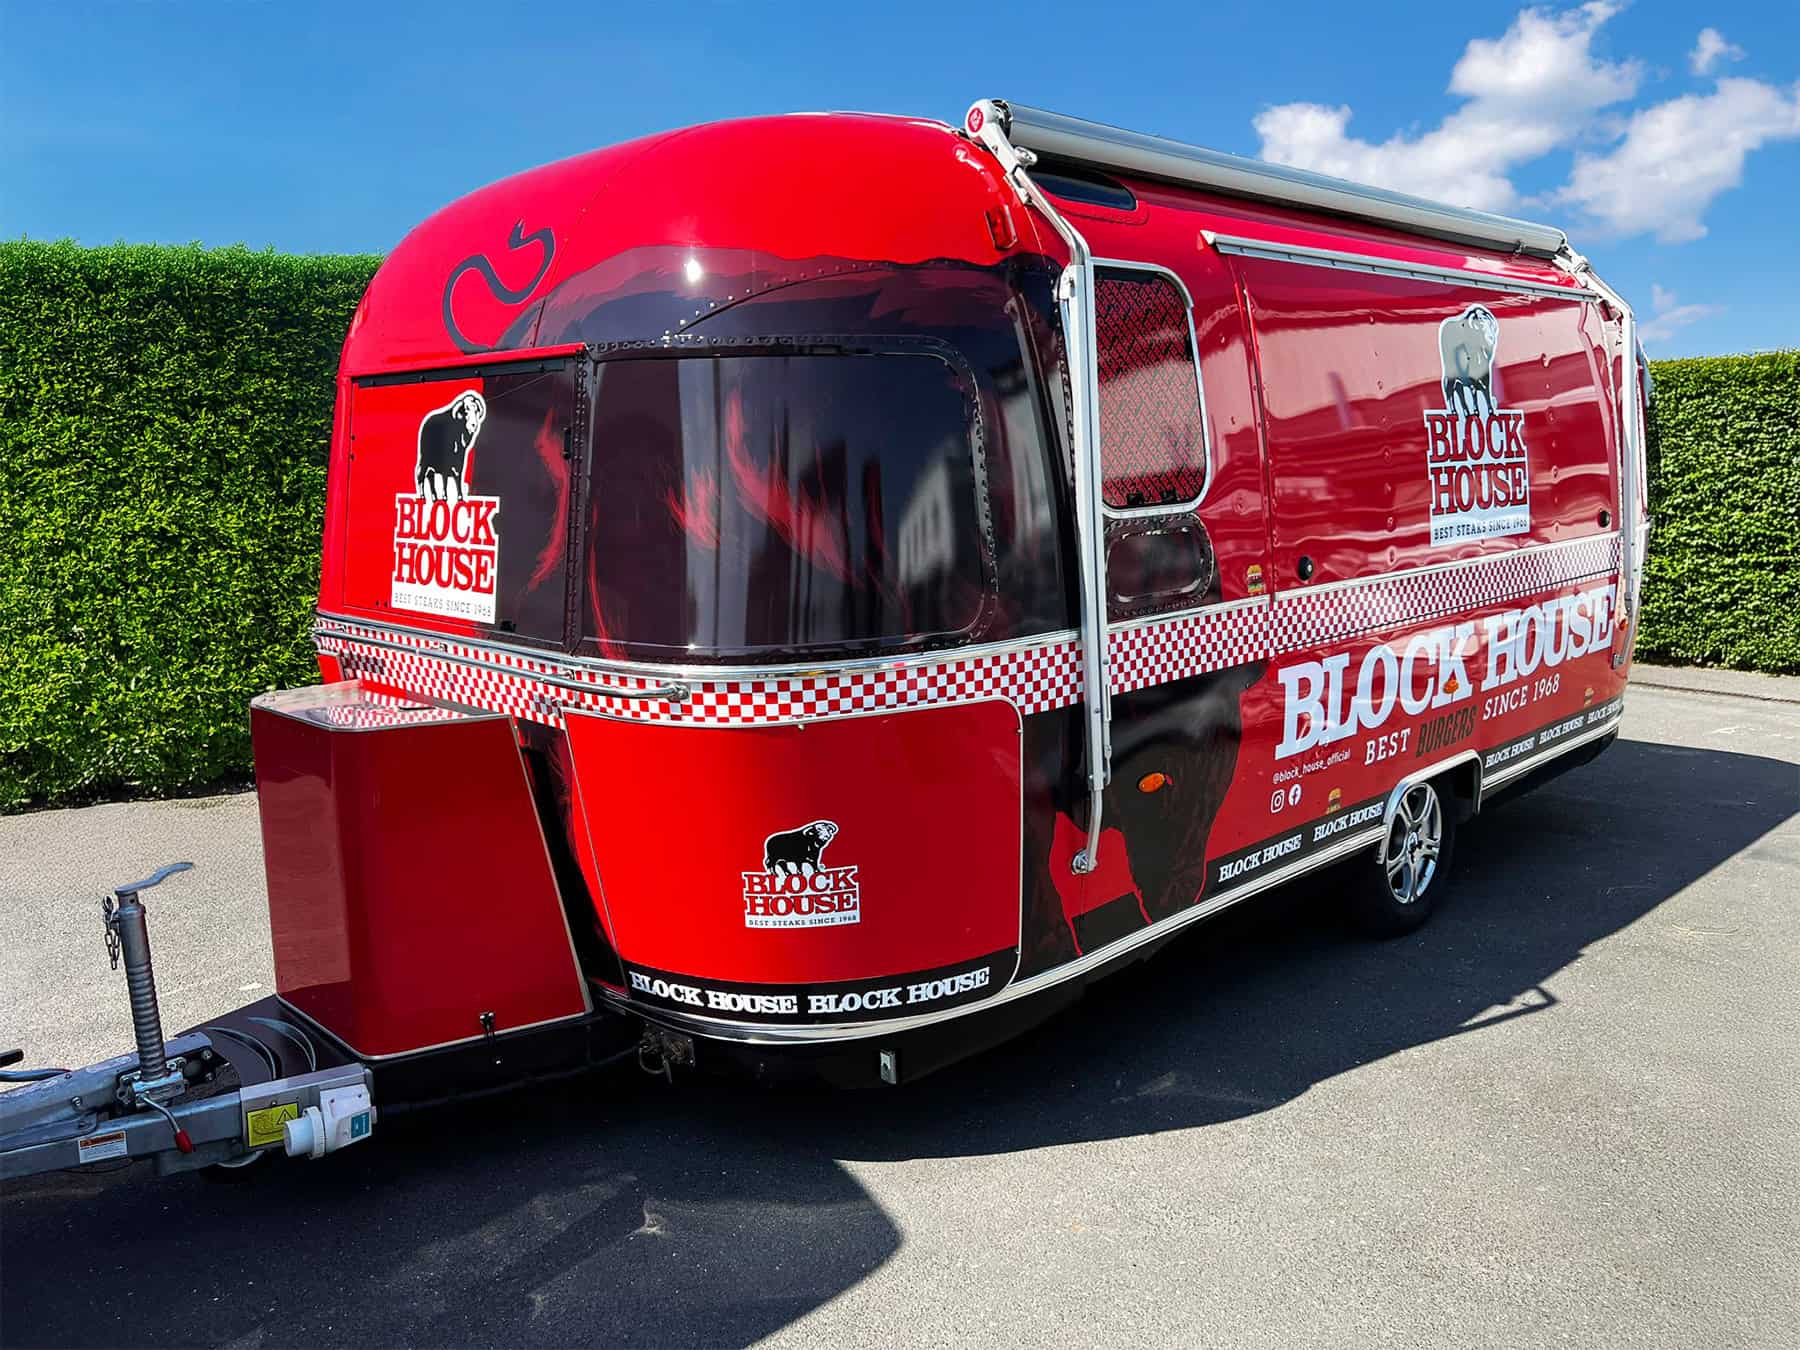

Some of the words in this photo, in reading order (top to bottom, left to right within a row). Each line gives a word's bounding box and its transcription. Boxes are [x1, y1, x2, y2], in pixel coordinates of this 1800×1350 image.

[1427, 413, 1525, 463] BLOCK
[1430, 461, 1528, 516] HOUSE
[397, 497, 497, 546] BLOCK
[1434, 526, 1454, 540] BEST
[1456, 522, 1486, 537] STEAKS
[1488, 518, 1511, 532] SINCE
[394, 541, 495, 594] HOUSE
[395, 592, 412, 605] BEST
[414, 595, 443, 610] STEAKS
[446, 600, 471, 614] SINCE
[1275, 622, 1474, 761] BLOCK
[1481, 583, 1618, 692] HOUSE
[1364, 728, 1412, 766] BEST
[1416, 704, 1479, 758] BURGERS
[1482, 686, 1528, 721] SINCE
[1533, 673, 1561, 702] 1968
[1539, 724, 1563, 744] BLOCK
[1561, 716, 1585, 735] HOUSE
[1272, 749, 1351, 785] @block_house_official
[1484, 746, 1512, 768] BLOCK
[1510, 736, 1536, 757] HOUSE
[1312, 816, 1350, 842] BLOCK
[1348, 802, 1385, 827] HOUSE
[1218, 851, 1263, 883] BLOCK
[1262, 834, 1303, 865] HOUSE
[743, 868, 857, 895] BLOCK
[745, 890, 857, 916] HOUSE
[748, 919, 769, 927] BEST
[772, 918, 806, 927] STEAKS
[809, 916, 835, 926] SINCE
[839, 914, 857, 923] 1968
[629, 971, 705, 1007] BLOCK
[705, 993, 798, 1014] HOUSE
[807, 987, 902, 1014] BLOCK
[906, 967, 990, 1004] HOUSE
